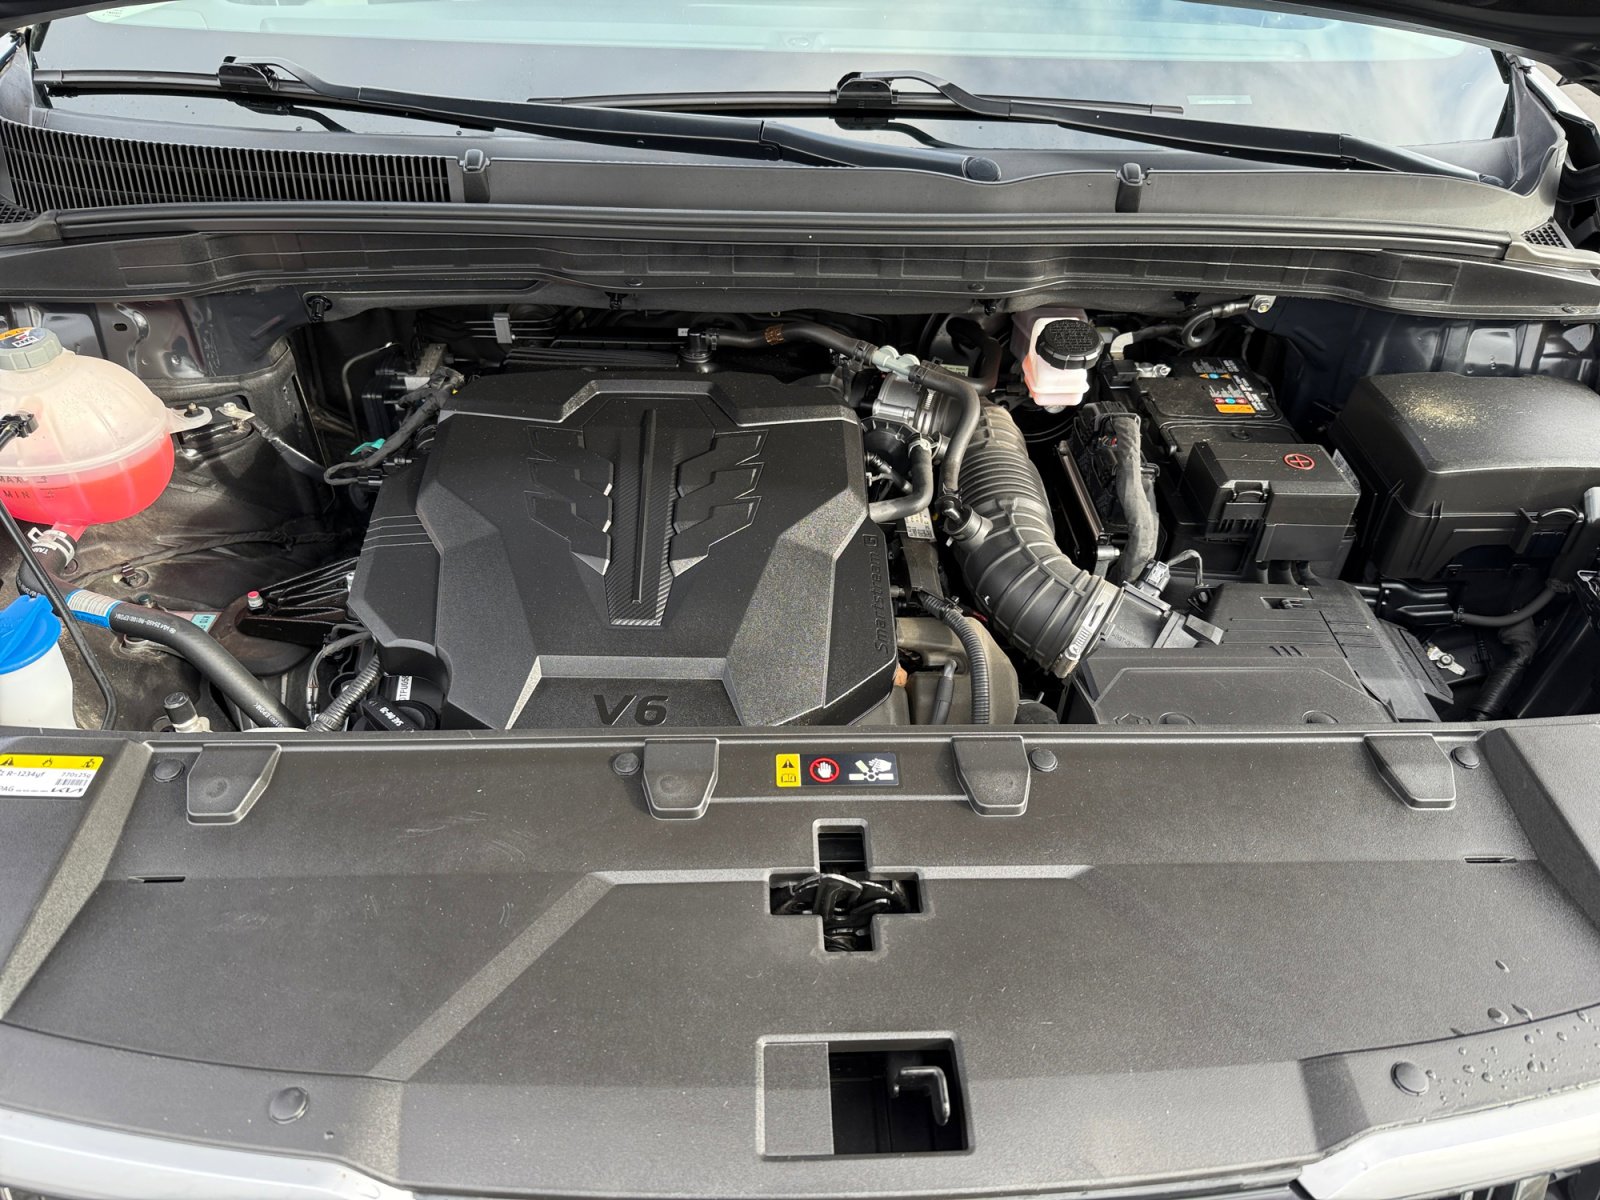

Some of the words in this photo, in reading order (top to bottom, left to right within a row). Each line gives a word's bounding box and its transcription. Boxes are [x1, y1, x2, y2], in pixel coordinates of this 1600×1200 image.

[3, 489, 30, 499] MIN
[862, 532, 878, 548] G
[868, 551, 889, 655] Smartstream
[593, 694, 669, 726] V6
[391, 716, 404, 727] SAE
[6, 770, 46, 778] R-1234yf
